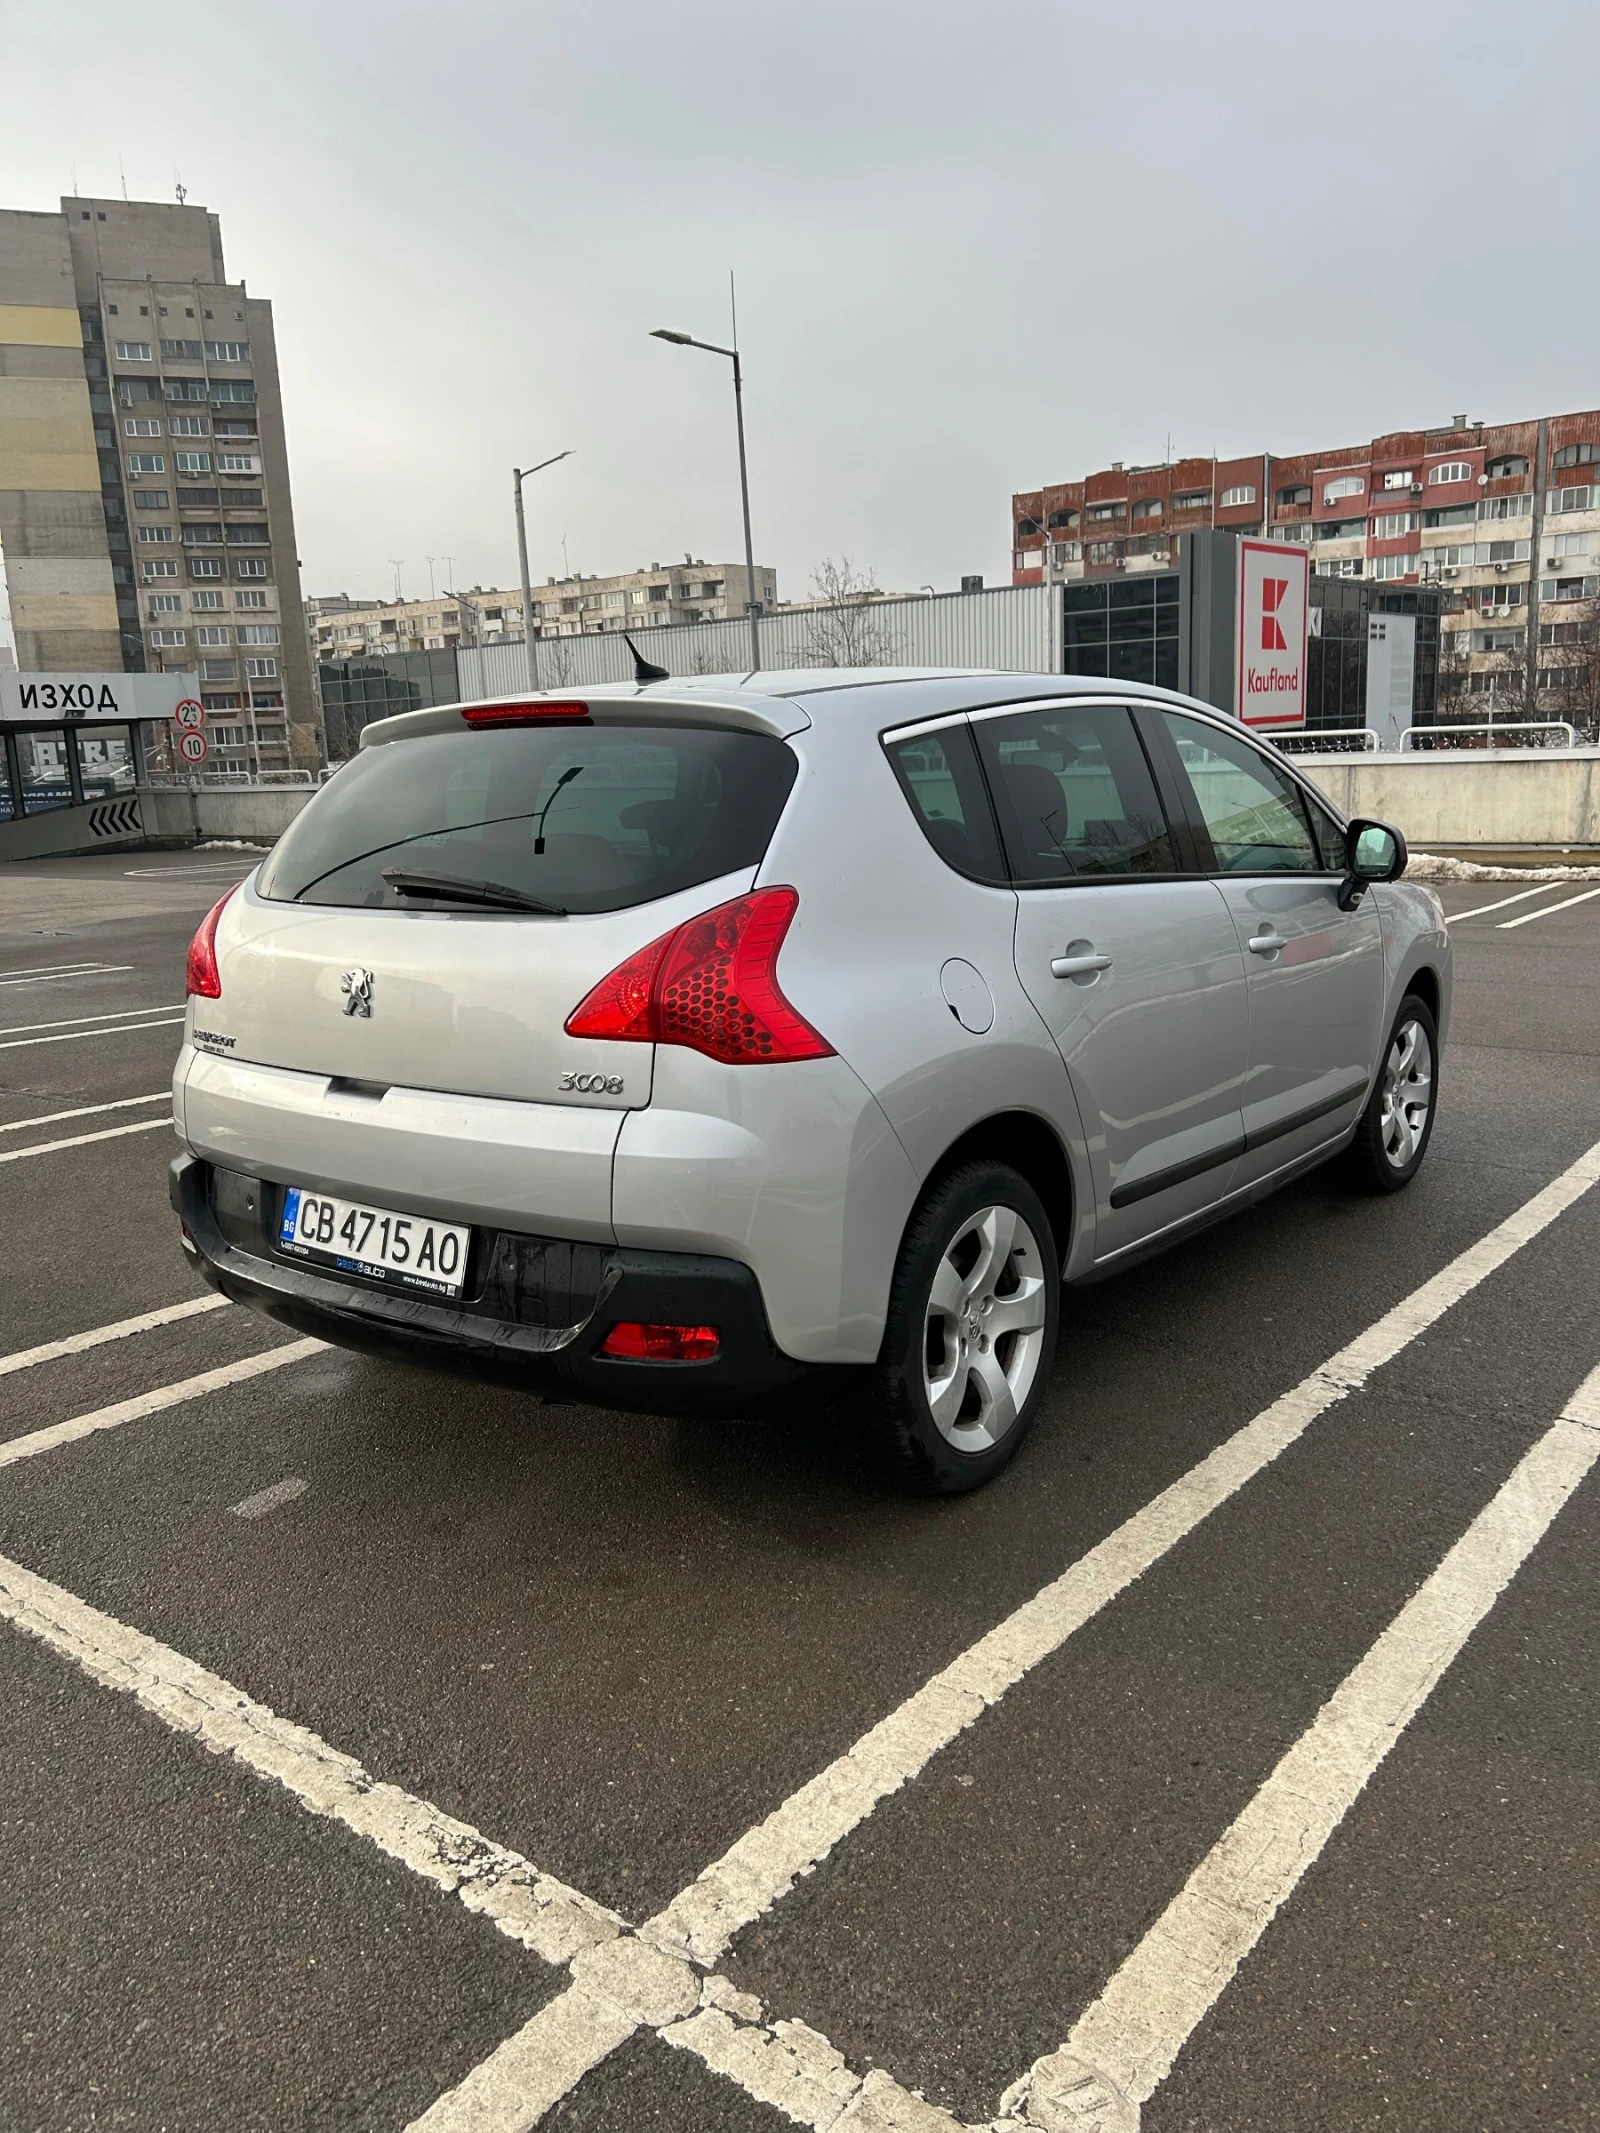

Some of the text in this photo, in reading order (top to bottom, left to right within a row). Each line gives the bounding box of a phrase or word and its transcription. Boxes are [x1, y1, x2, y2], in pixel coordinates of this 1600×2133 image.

[1248, 667, 1298, 693] Kaufland
[19, 683, 119, 712] ИЗХОД
[187, 740, 201, 756] 10
[557, 1071, 624, 1095] 3008
[283, 1219, 295, 1233] BG
